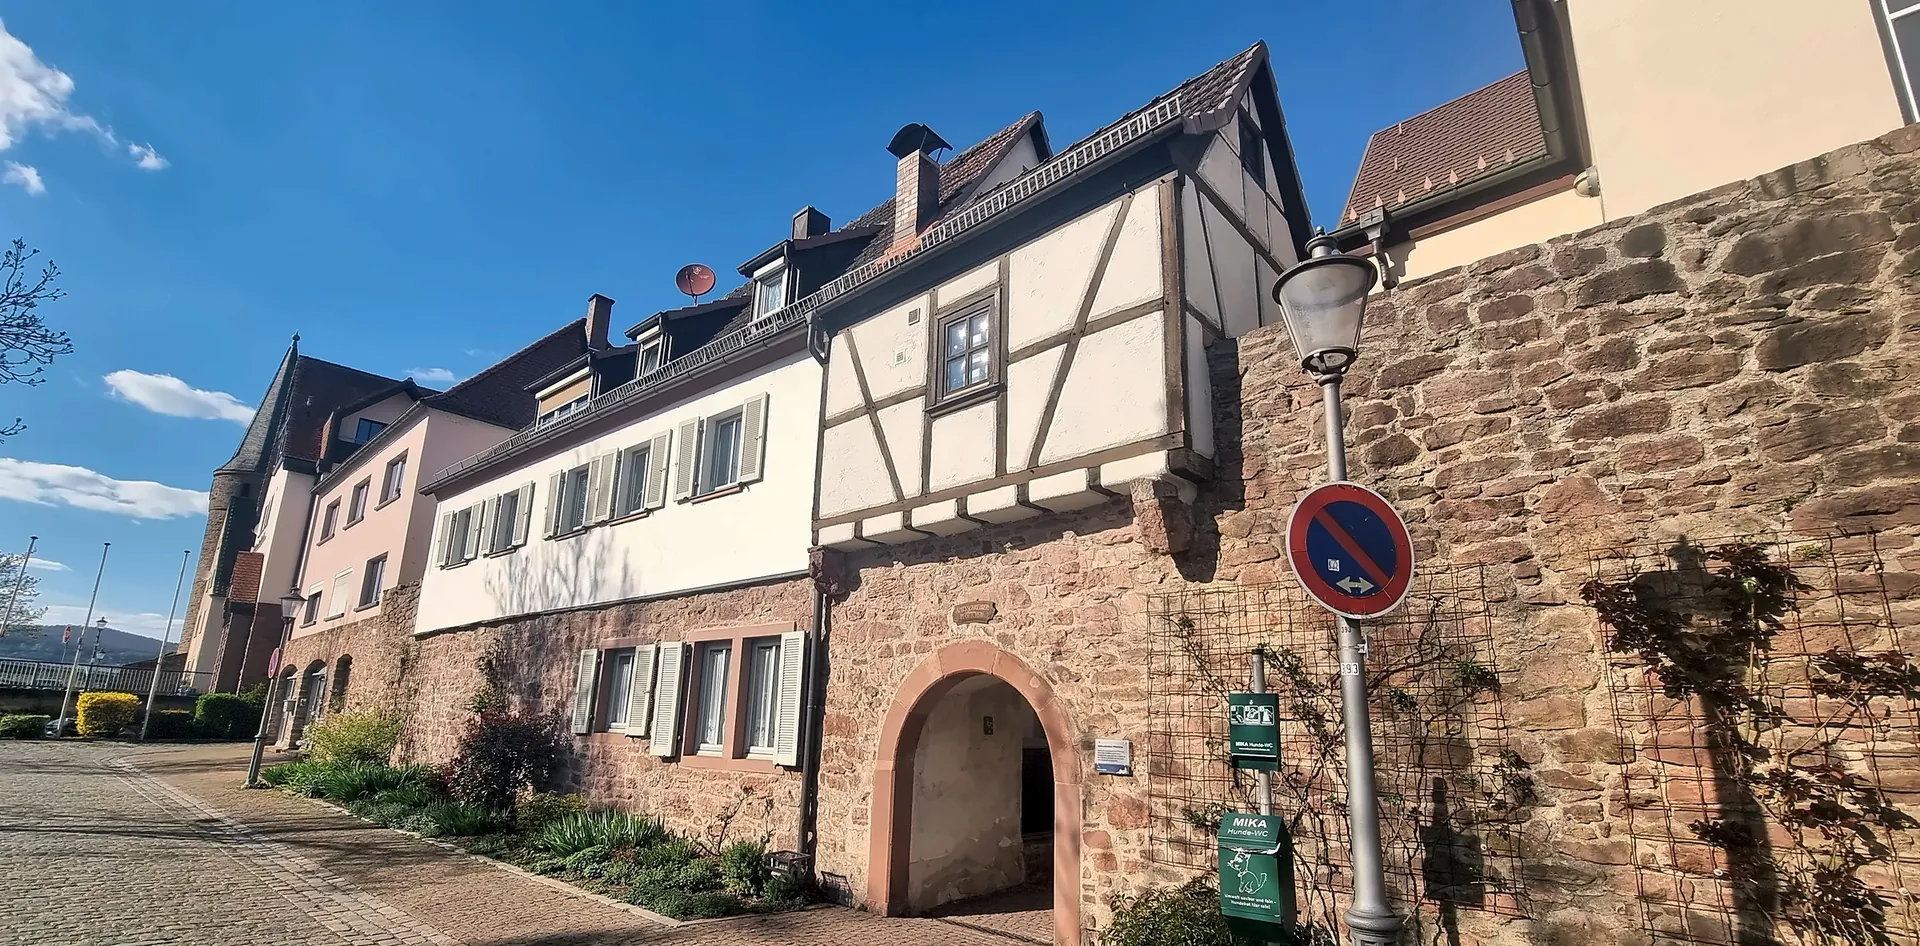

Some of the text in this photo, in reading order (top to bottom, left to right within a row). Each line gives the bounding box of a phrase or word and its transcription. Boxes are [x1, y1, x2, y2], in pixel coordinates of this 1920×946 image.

[1342, 663, 1359, 674] 393
[1232, 817, 1267, 829] MIKA
[1227, 828, 1269, 838] Hunde-WC
